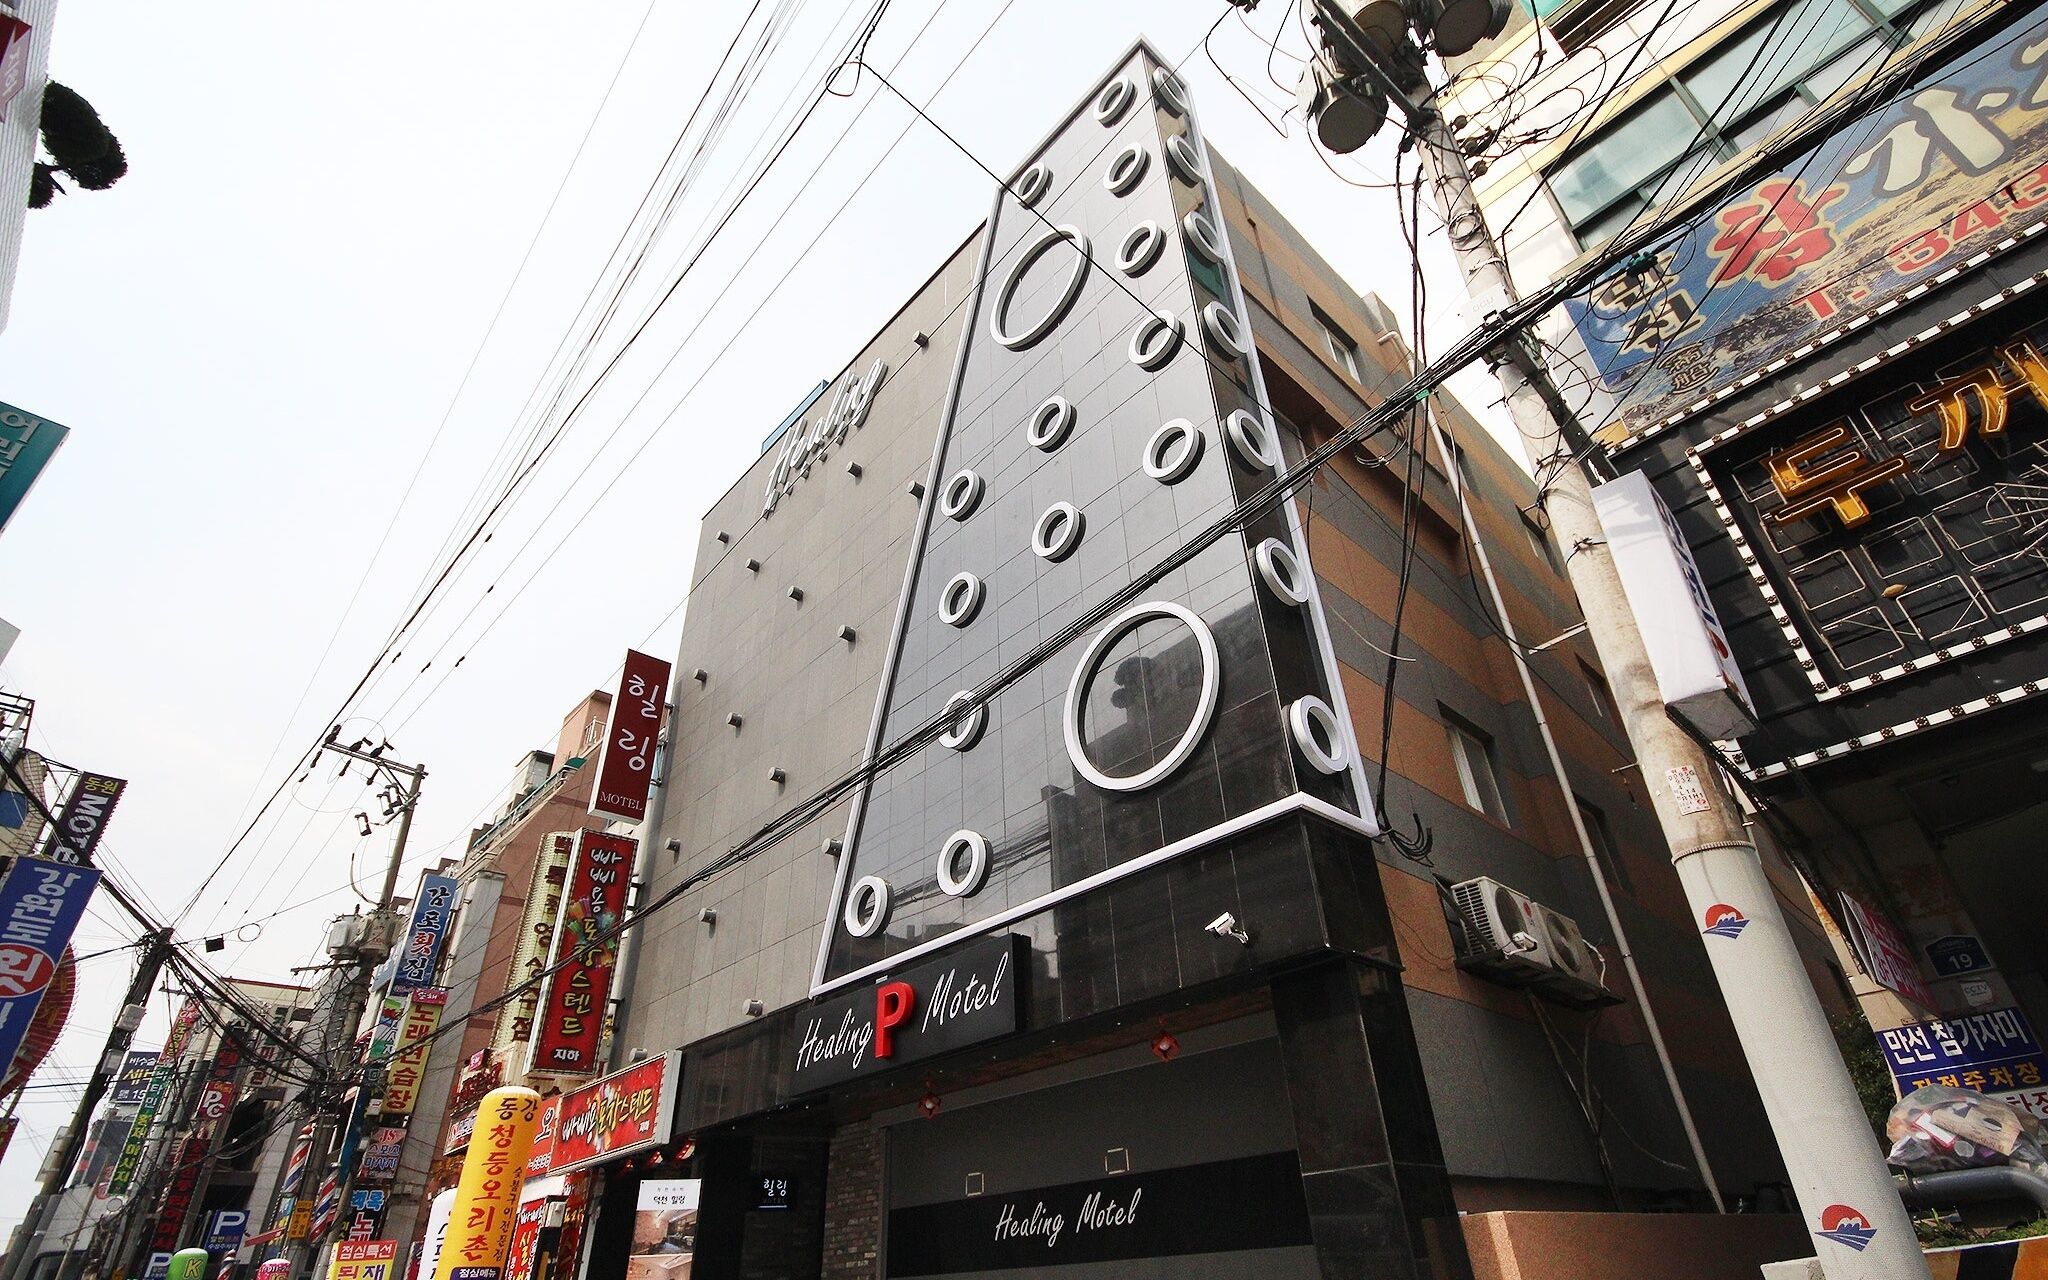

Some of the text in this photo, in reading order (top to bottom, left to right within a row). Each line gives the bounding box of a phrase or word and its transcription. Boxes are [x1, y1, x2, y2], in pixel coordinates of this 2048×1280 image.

[763, 357, 888, 516] Healing
[616, 674, 659, 771] 힐링
[600, 791, 643, 811] MOTEL
[403, 886, 451, 982] 감포횟집
[1949, 953, 1973, 971] 19
[1964, 982, 1988, 995] CCTV
[796, 951, 1009, 1070] Healing P Motel
[1883, 1009, 2029, 1065] 만선 참가자미
[386, 1002, 440, 1111] 노래연습장
[553, 1048, 581, 1063] 지하
[202, 1090, 225, 1118] PC
[495, 1097, 539, 1121] 동강
[459, 1124, 517, 1263] 청둥오리촌
[763, 1178, 787, 1197] 힐링
[213, 1211, 245, 1235] P
[995, 1188, 1143, 1248] Healing Motel
[340, 1243, 393, 1260] 점심특선
